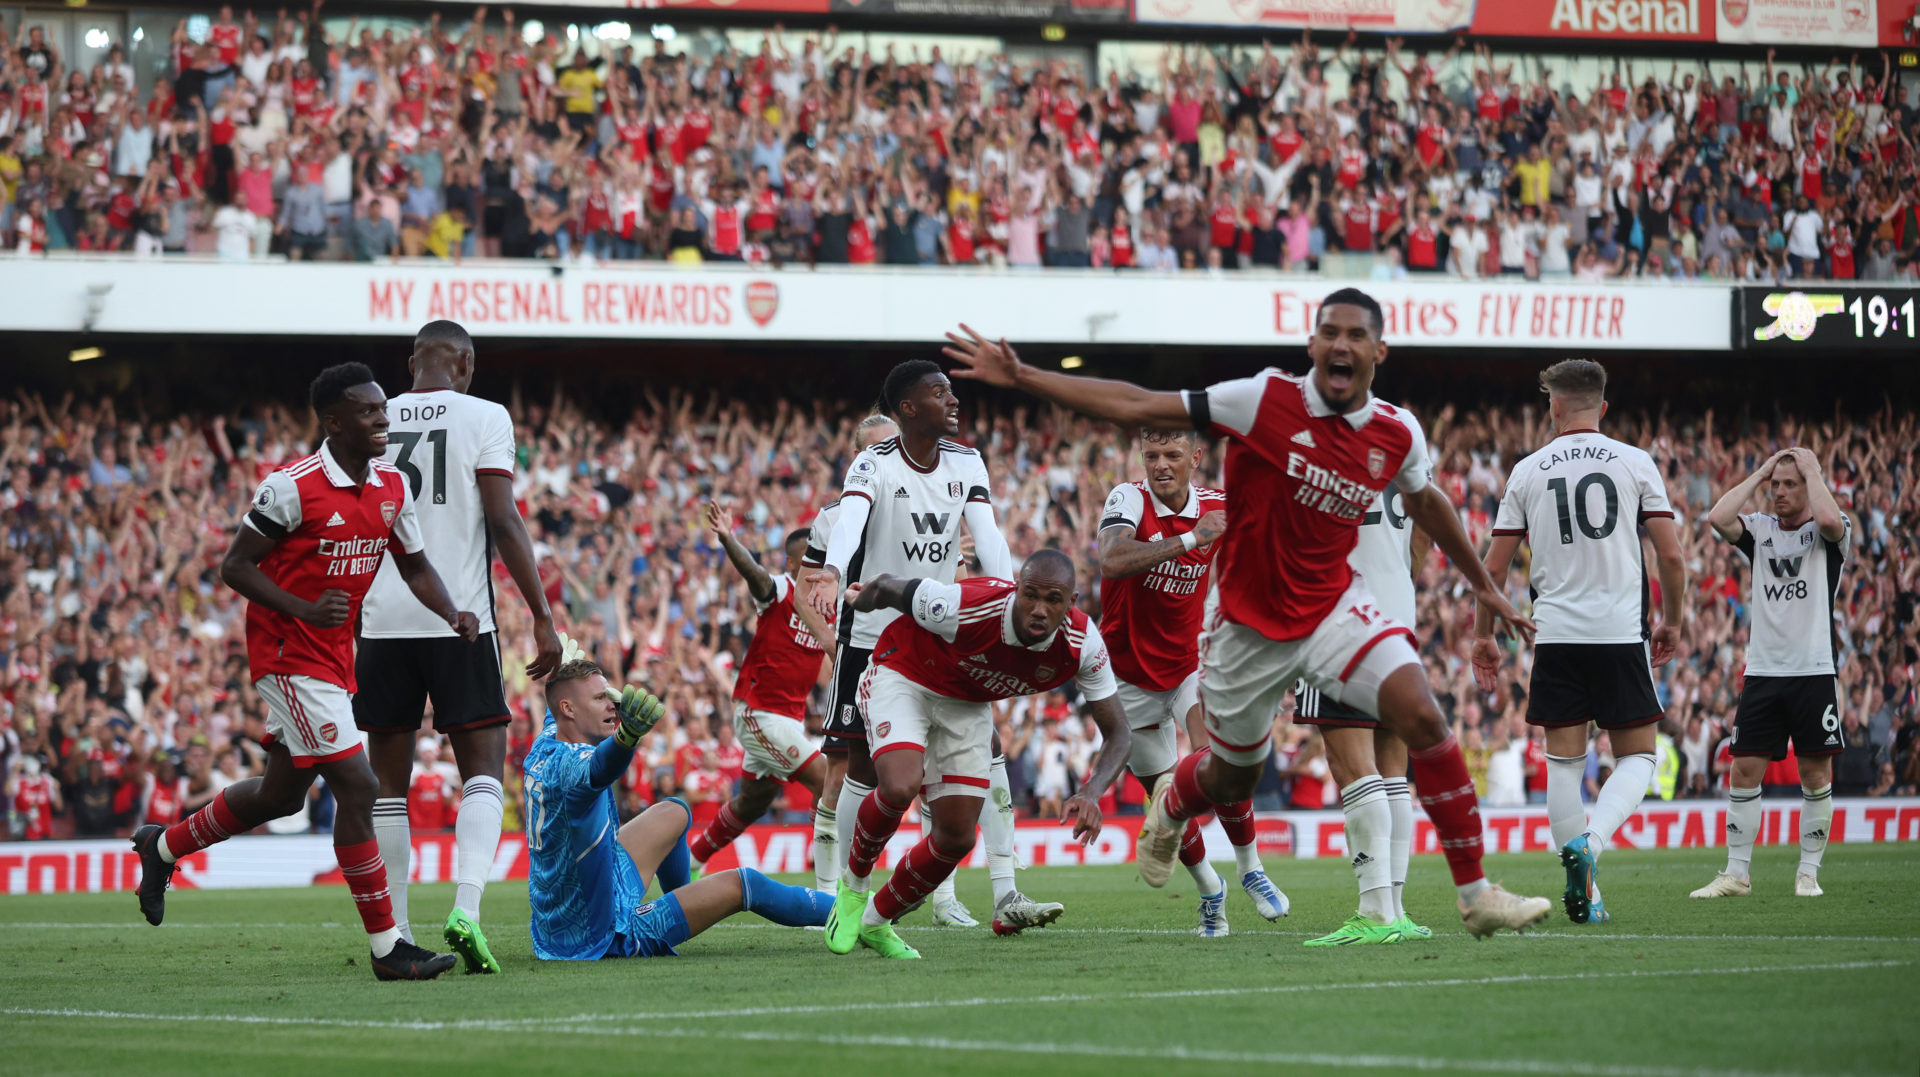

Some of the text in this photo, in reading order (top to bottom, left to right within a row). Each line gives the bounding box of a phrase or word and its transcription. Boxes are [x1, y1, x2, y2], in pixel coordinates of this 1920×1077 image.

[1550, 0, 1699, 33] Arsenal
[369, 281, 731, 325] MY ARSENAL REWARDS
[1273, 292, 1624, 338] Eates FLY BETTER
[400, 405, 447, 422] DIOP
[1539, 447, 1618, 471] CAIRNEY
[1547, 472, 1618, 544] 10
[317, 534, 389, 557] Emirate
[326, 559, 349, 576] FLY
[1143, 574, 1199, 595] FLY BETTER
[1763, 580, 1808, 602] W88
[1821, 703, 1839, 733] 6
